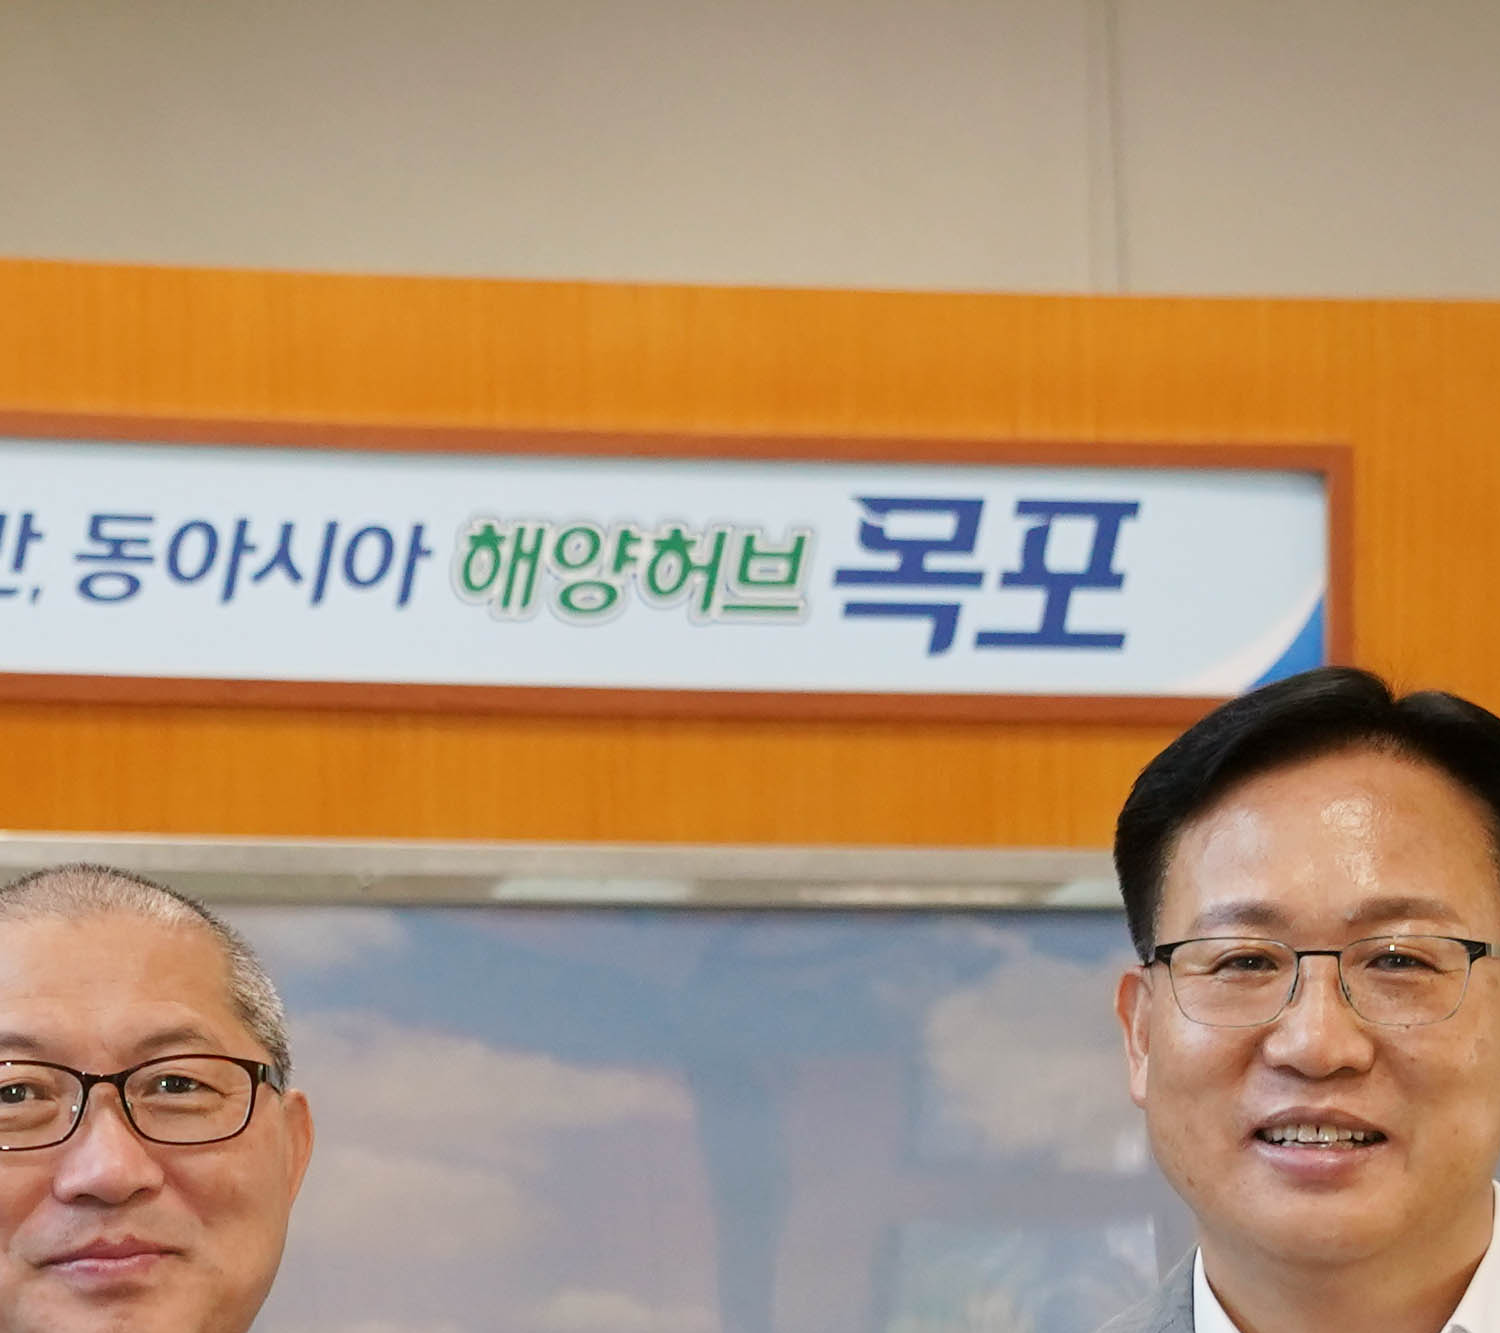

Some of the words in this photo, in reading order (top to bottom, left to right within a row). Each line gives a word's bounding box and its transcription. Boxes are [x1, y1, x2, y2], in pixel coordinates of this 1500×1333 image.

[74, 512, 433, 609] 동아시아
[458, 519, 812, 624] 해양허브
[833, 496, 1140, 657] 목포
